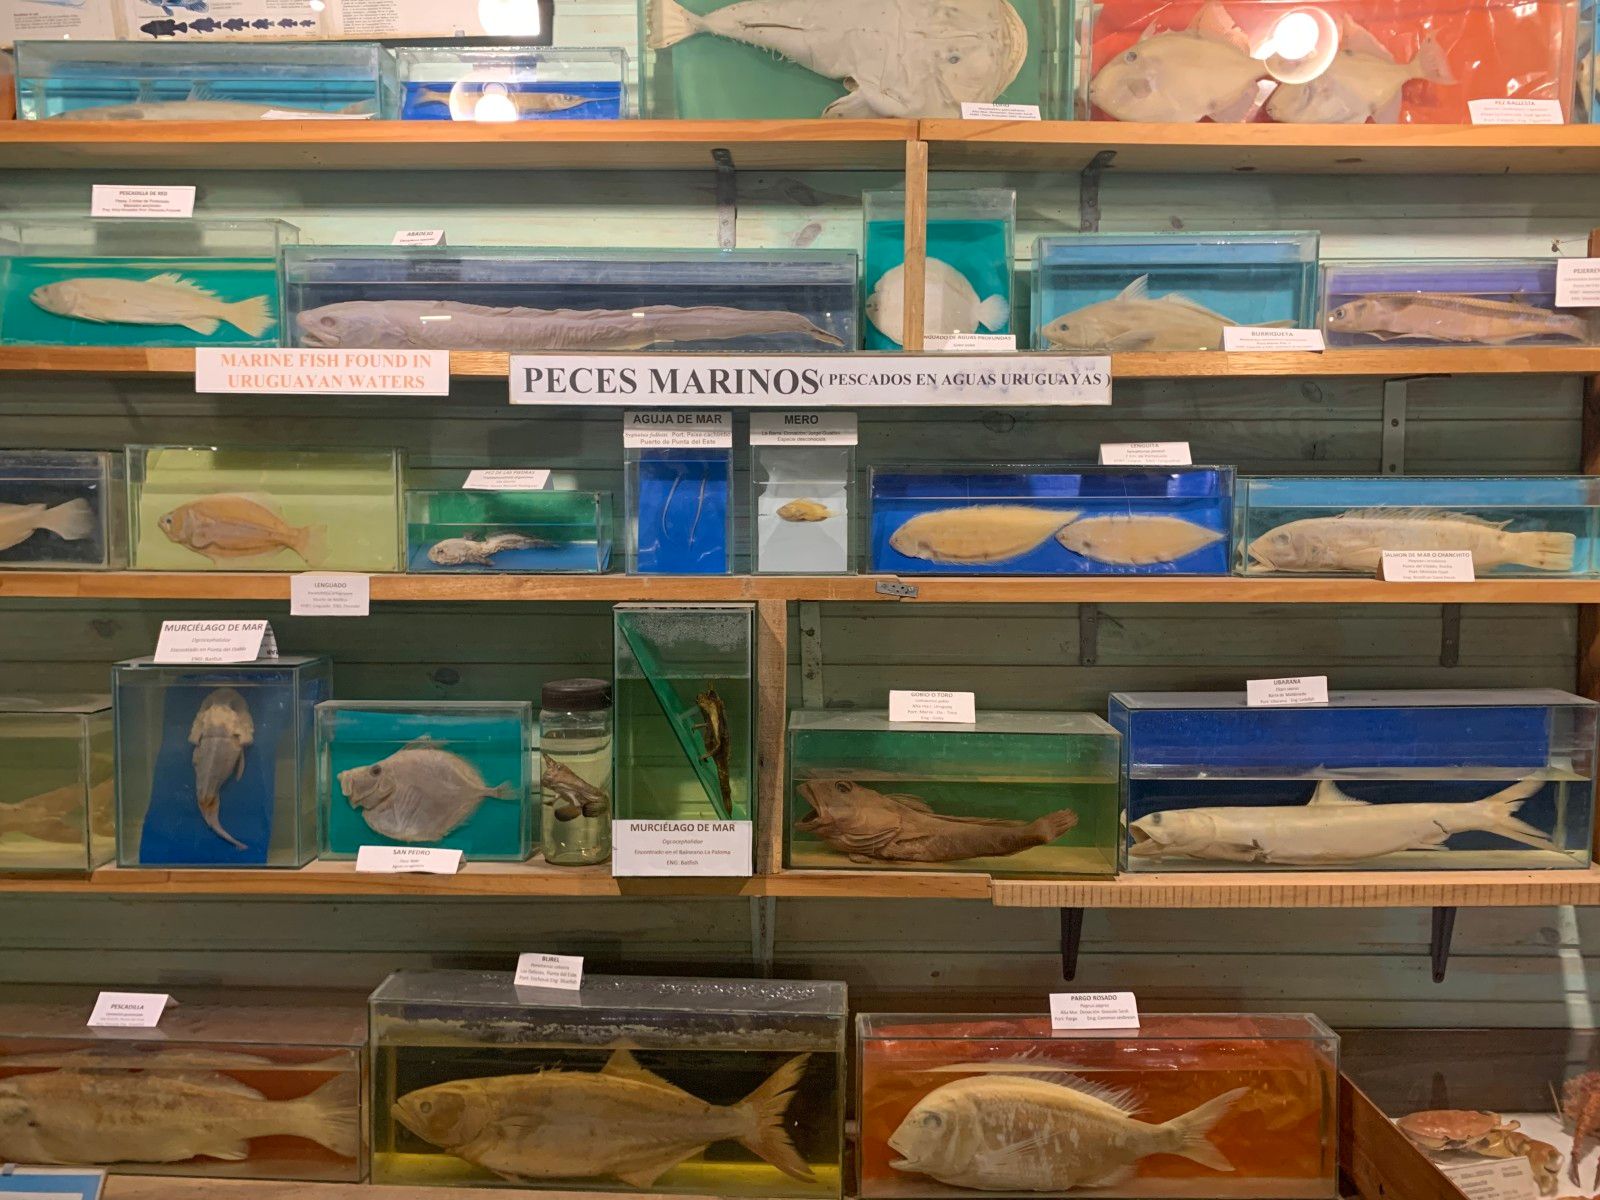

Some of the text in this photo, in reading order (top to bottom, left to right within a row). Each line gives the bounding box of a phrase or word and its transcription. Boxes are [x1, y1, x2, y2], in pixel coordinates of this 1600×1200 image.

[221, 354, 432, 369] MARINE FISH FOUND IN
[228, 374, 425, 389] URUGUAYAN WATERS
[522, 366, 637, 395] PECES
[647, 367, 819, 396] MARINOS
[915, 373, 938, 386] EN
[941, 373, 997, 387] AGUAS
[633, 413, 723, 424] AGUJA DE MAR
[784, 414, 819, 425] MERO
[164, 622, 264, 632] MURCIÉLAGO DE MAR
[630, 822, 736, 832] MURCIÉLAGO DE MAR
